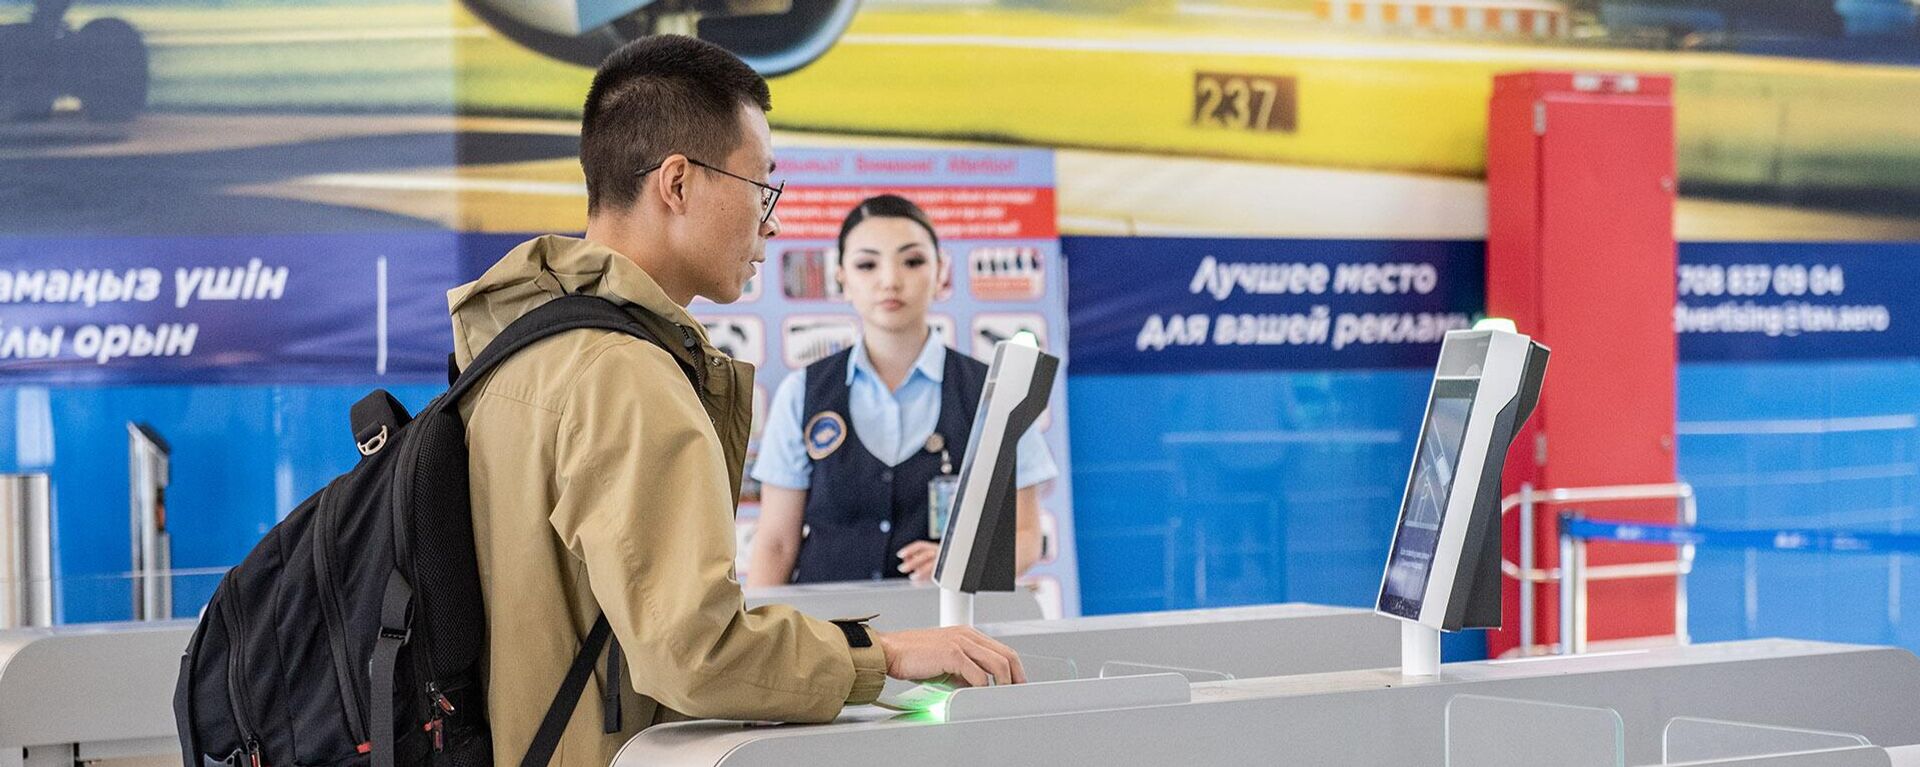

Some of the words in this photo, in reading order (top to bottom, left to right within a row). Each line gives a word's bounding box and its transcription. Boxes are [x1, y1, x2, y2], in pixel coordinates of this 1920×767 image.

[1199, 78, 1277, 130] 237
[175, 257, 289, 308] үшін
[1190, 255, 1330, 301] Лучшее
[1333, 262, 1438, 294] место
[0, 321, 65, 359] лы
[73, 322, 199, 364] орын
[1136, 313, 1211, 351] для
[1212, 304, 1331, 346] вашей
